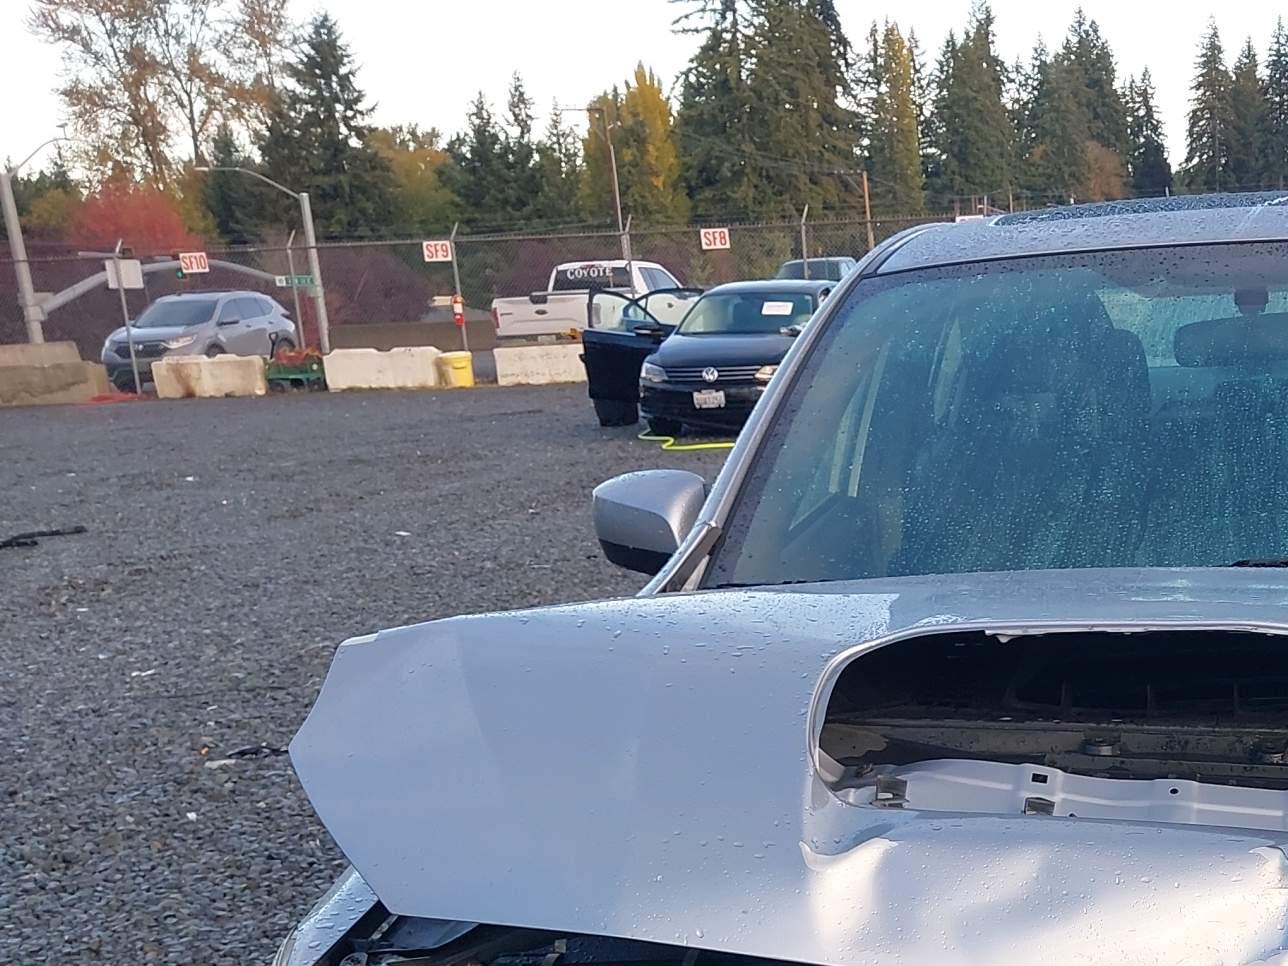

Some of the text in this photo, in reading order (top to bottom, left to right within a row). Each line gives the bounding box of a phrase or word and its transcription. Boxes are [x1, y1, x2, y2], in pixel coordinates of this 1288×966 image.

[703, 230, 727, 246] SF8
[425, 243, 449, 259] SF9
[181, 255, 207, 270] SF10
[566, 267, 613, 280] COYOTE
